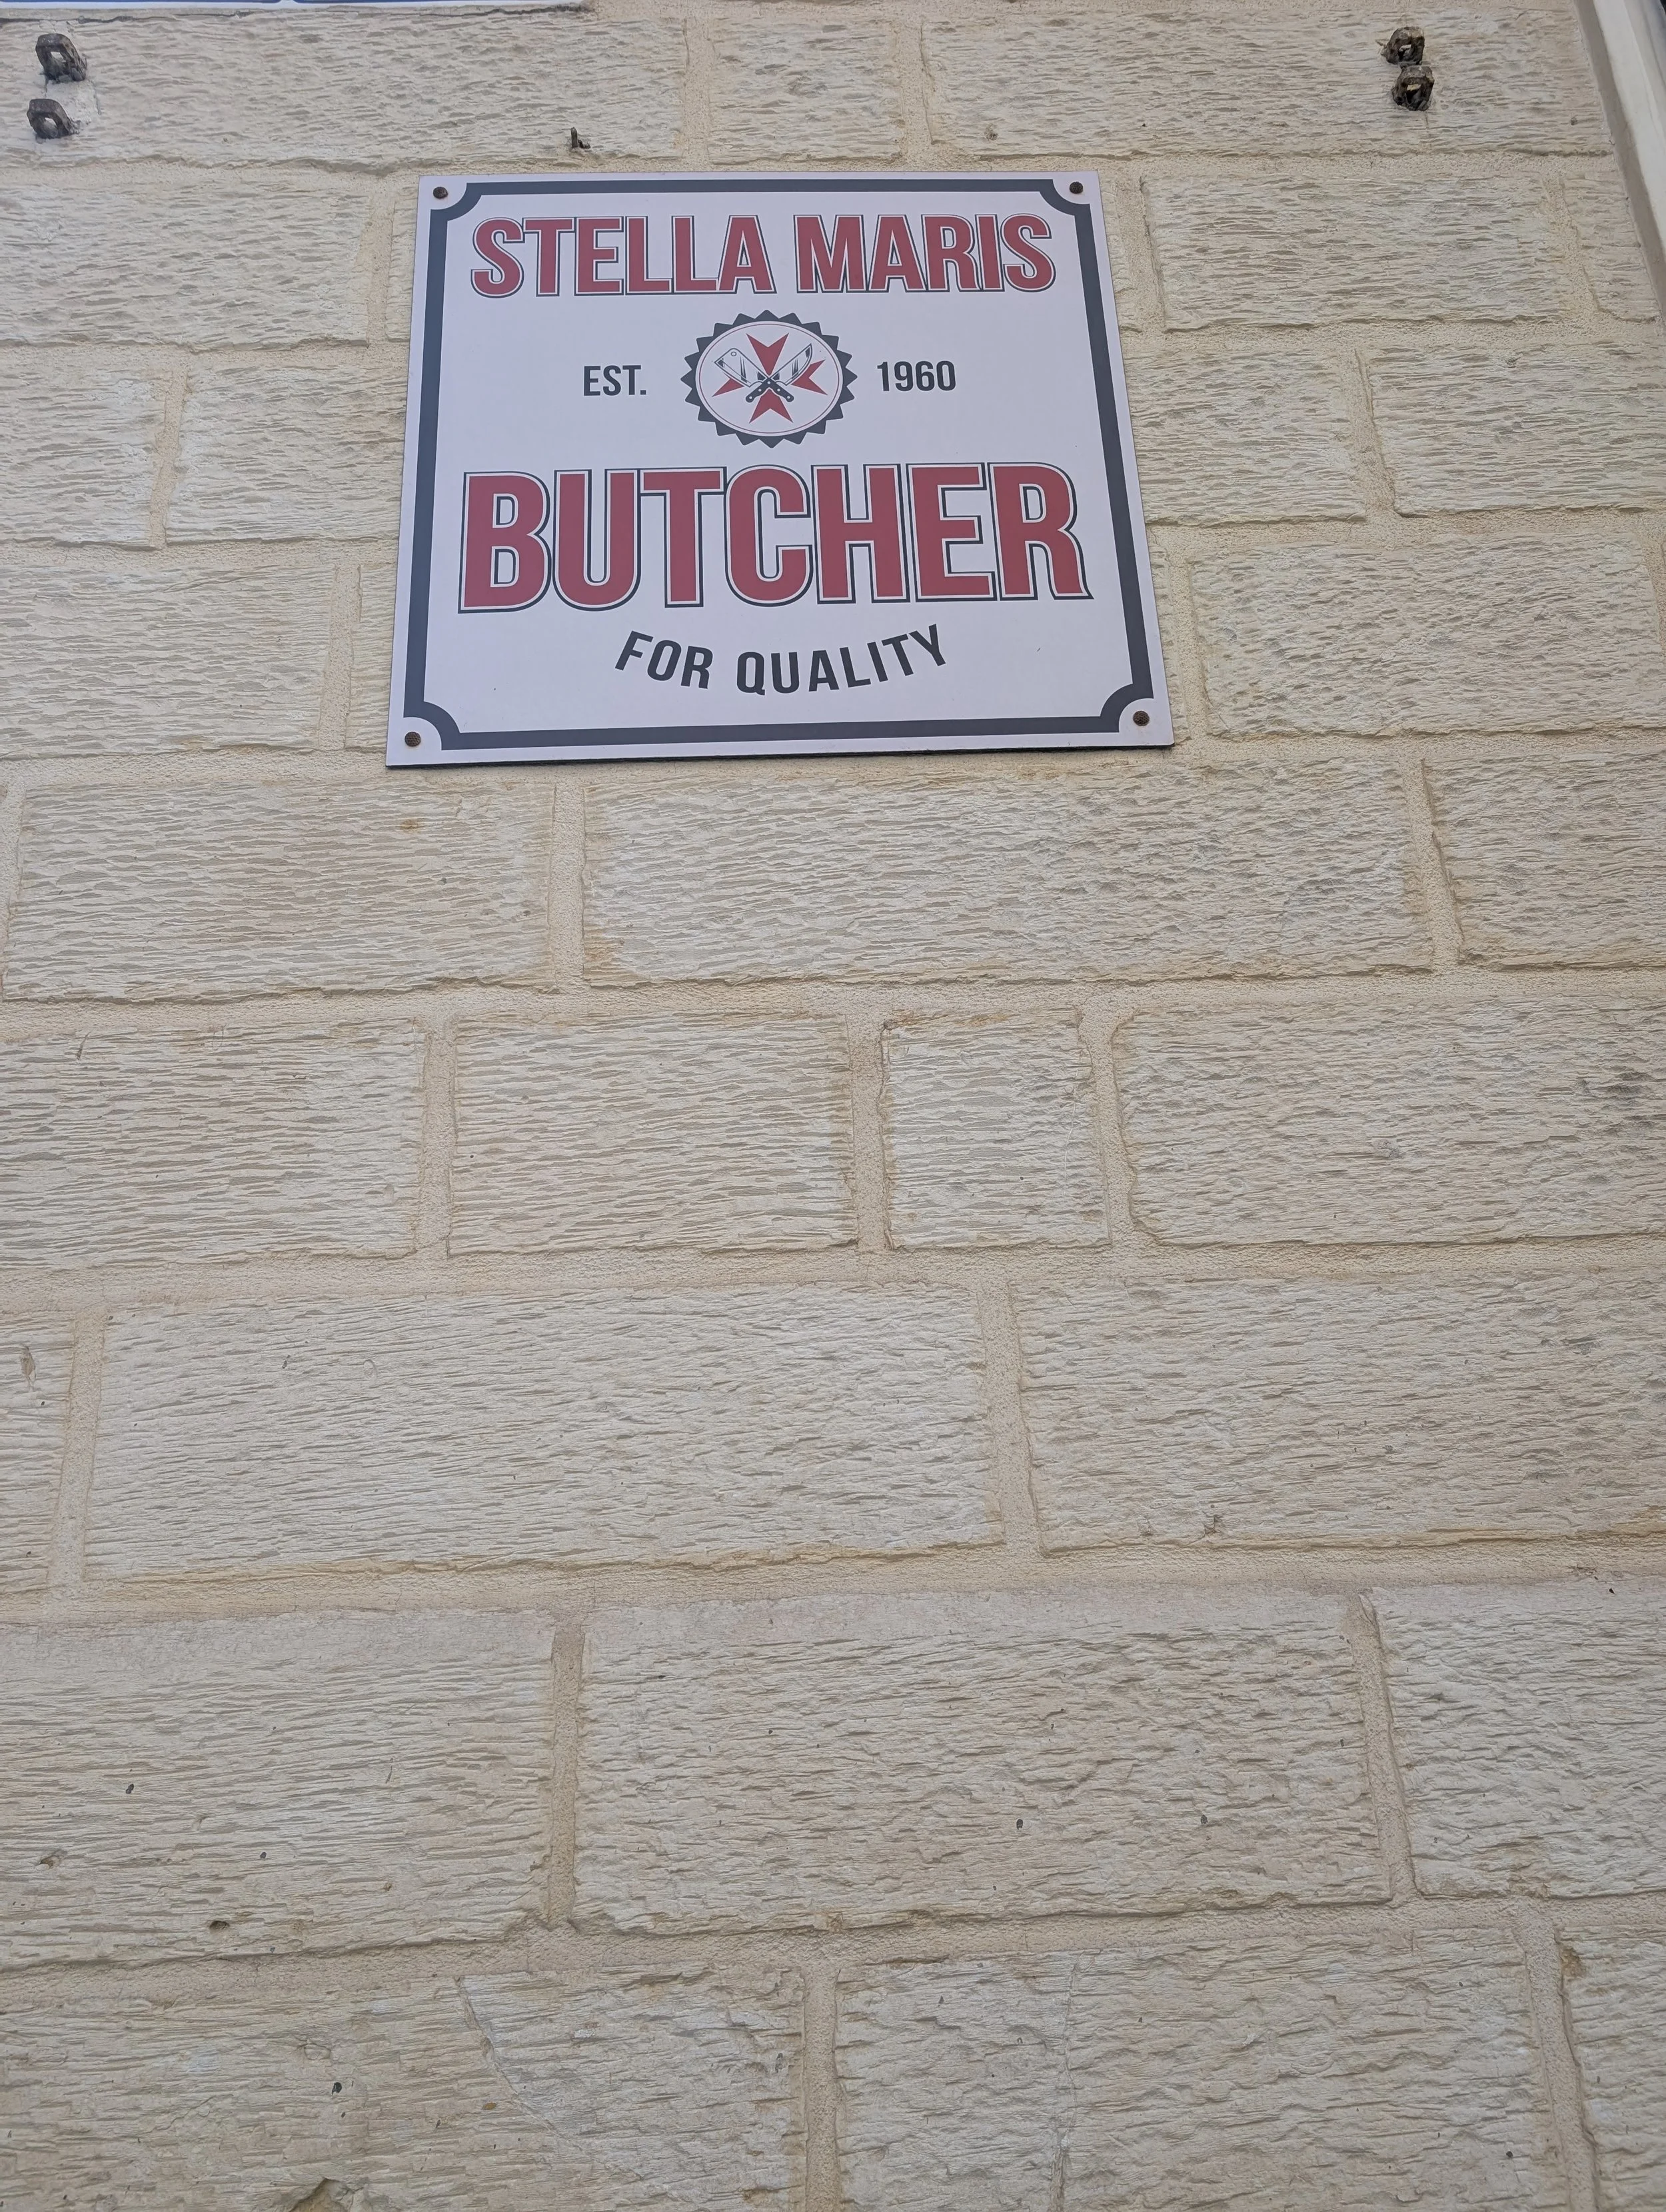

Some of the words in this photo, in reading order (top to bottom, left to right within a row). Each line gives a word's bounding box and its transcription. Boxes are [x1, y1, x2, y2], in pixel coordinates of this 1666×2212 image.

[470, 215, 778, 298] STELLA
[793, 214, 1057, 294] MARIS
[583, 364, 648, 397] EST.
[876, 360, 957, 392] 1960
[457, 461, 1095, 614] BUTCHER
[614, 630, 714, 690] FOR
[736, 623, 948, 696] QUALITY
